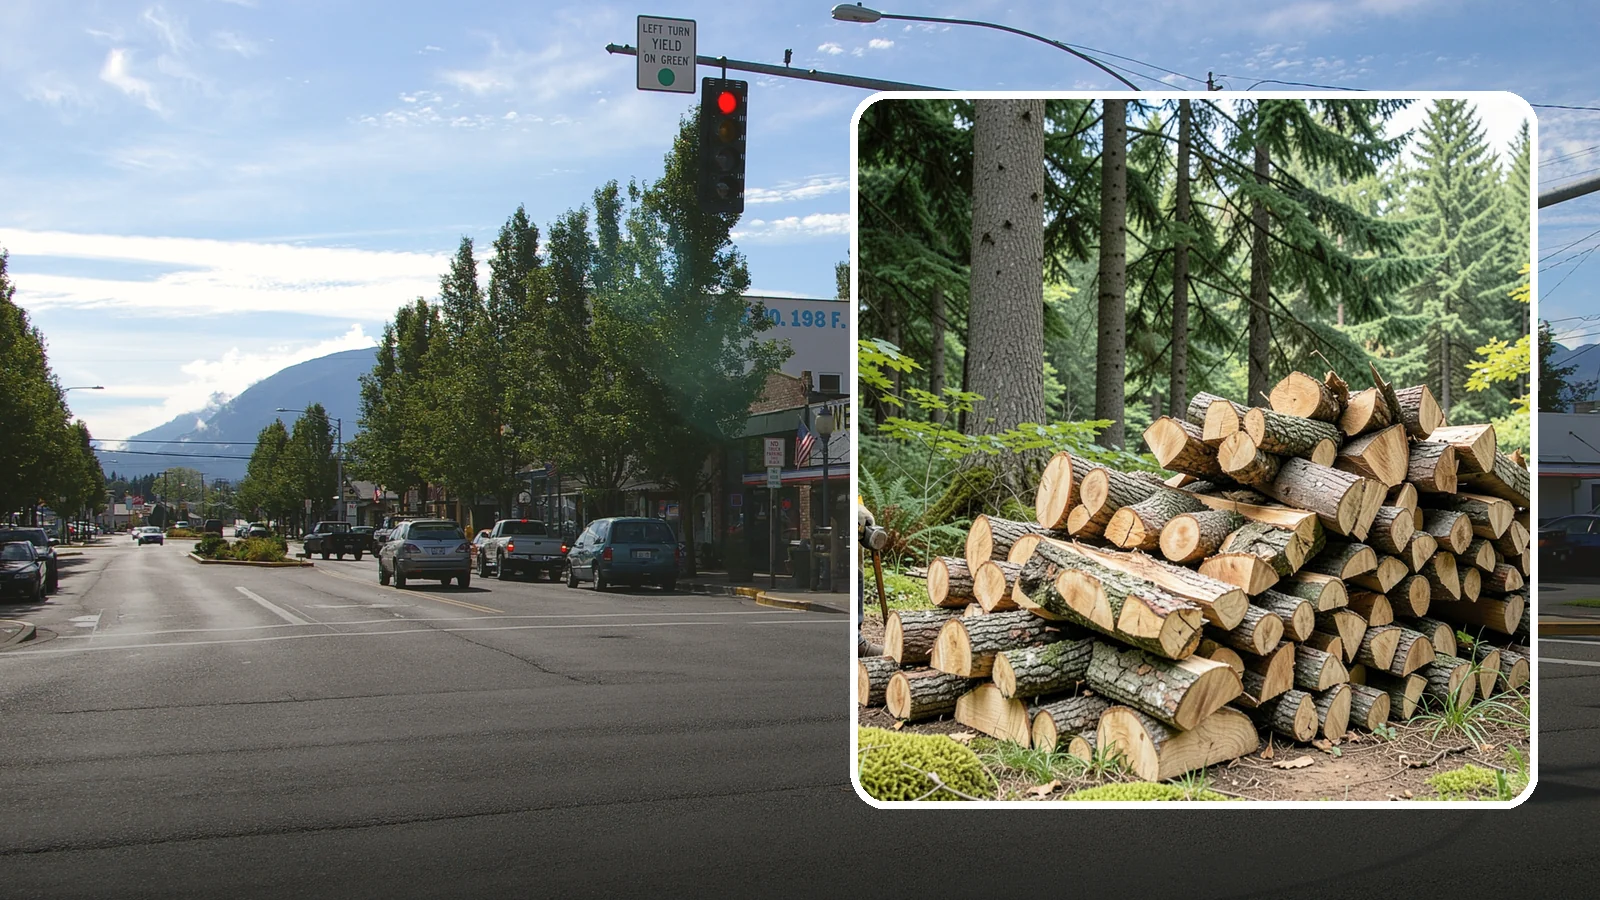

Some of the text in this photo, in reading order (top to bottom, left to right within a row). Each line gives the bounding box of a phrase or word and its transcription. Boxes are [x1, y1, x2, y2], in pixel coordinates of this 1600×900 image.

[643, 24, 690, 36] LEFT TURN
[652, 38, 682, 51] YIELD
[644, 53, 688, 66] ON GREEN
[791, 309, 826, 328] 198
[831, 311, 846, 329] F.
